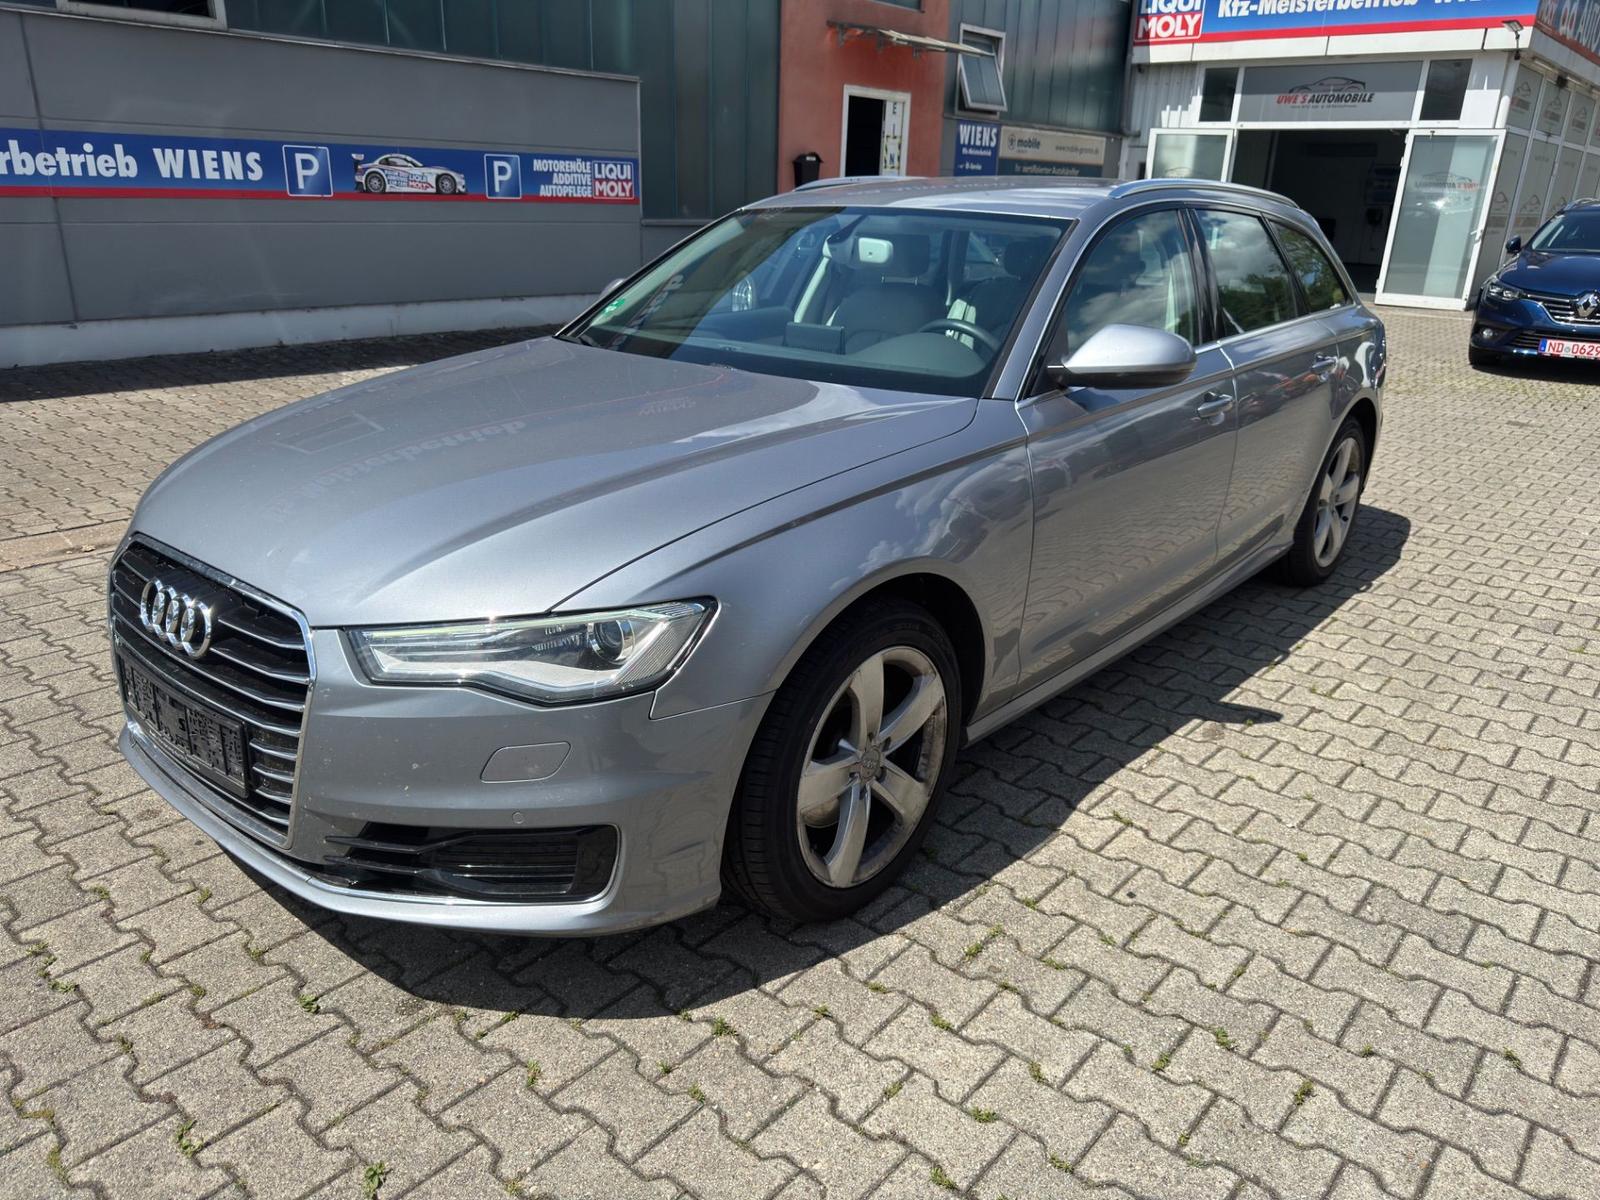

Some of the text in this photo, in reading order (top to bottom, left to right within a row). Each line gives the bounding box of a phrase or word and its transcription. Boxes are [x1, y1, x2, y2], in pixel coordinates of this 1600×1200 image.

[1217, 0, 1418, 18] Kfz-Meistere
[1137, 14, 1202, 38] MOLY
[1307, 92, 1375, 104] AUTOMOBILE
[959, 124, 997, 147] WIENS
[0, 139, 263, 181] rbetrieb WIENS
[533, 158, 591, 173] MOTORENÖLE
[294, 152, 320, 189] P
[493, 160, 512, 192] P
[594, 163, 632, 180] LIQUI
[552, 173, 592, 186] ADDITIVE
[539, 184, 592, 198] AUTOPFLEGE
[595, 181, 633, 197] MOLY
[1548, 342, 1565, 353] ND
